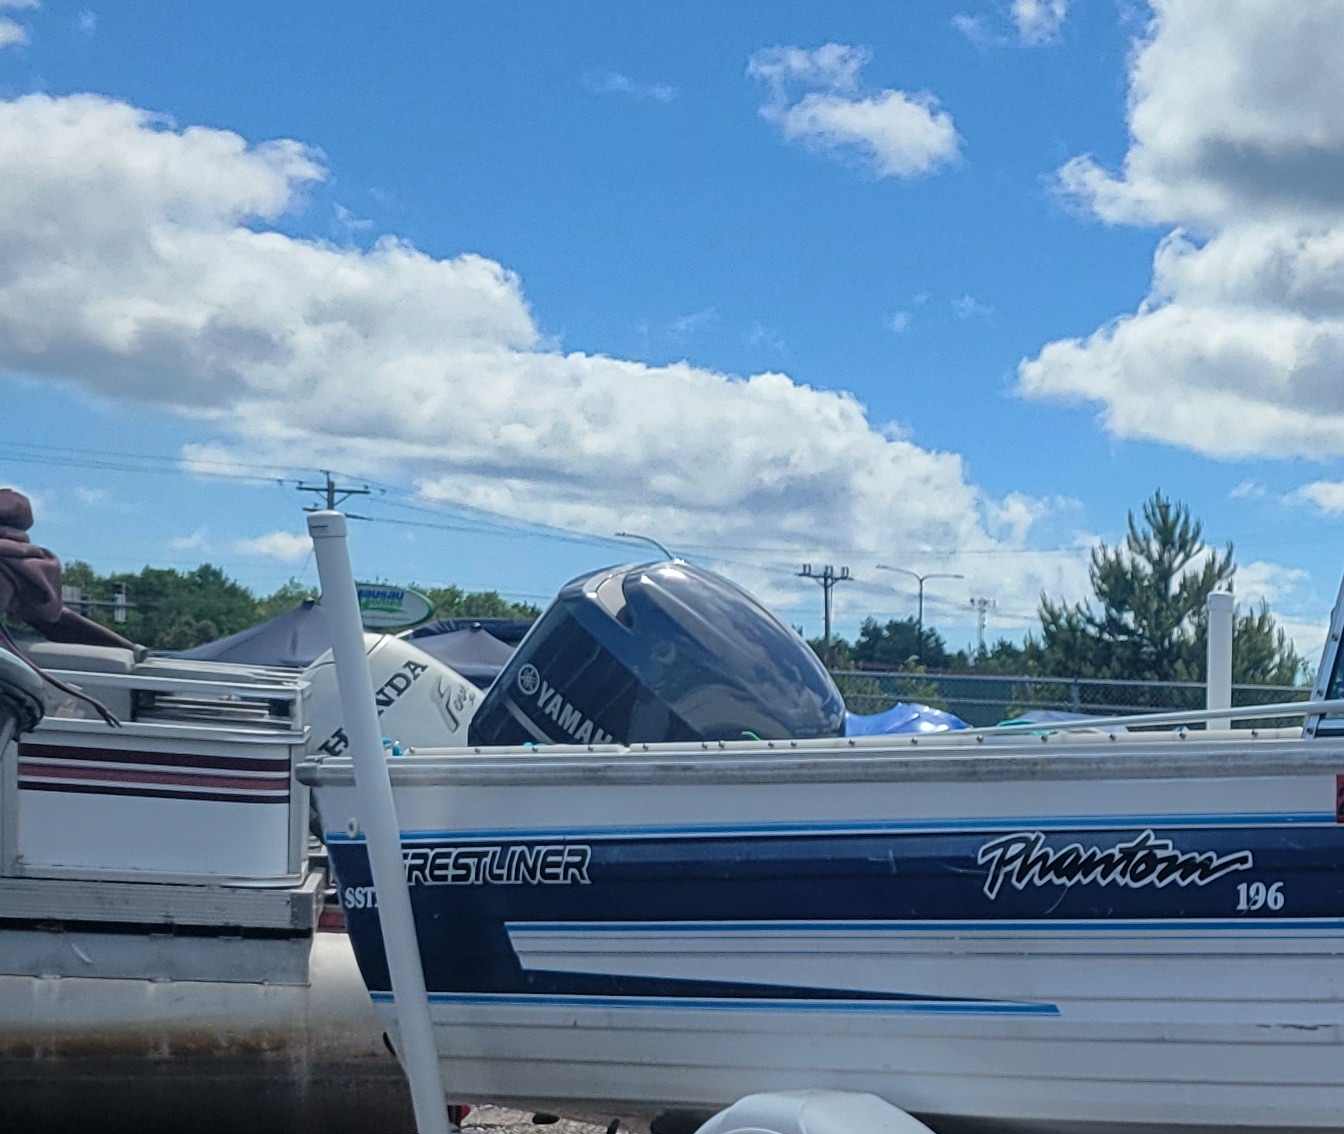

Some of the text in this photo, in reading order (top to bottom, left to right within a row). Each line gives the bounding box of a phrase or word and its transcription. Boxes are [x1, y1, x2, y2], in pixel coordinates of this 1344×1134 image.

[357, 589, 405, 600] ausau
[318, 659, 429, 756] HNDA
[537, 681, 613, 744] YAMAH
[402, 845, 591, 885] RESTLINER
[977, 829, 1252, 899] Phantom
[344, 887, 379, 909] SST
[1236, 882, 1285, 911] 196
